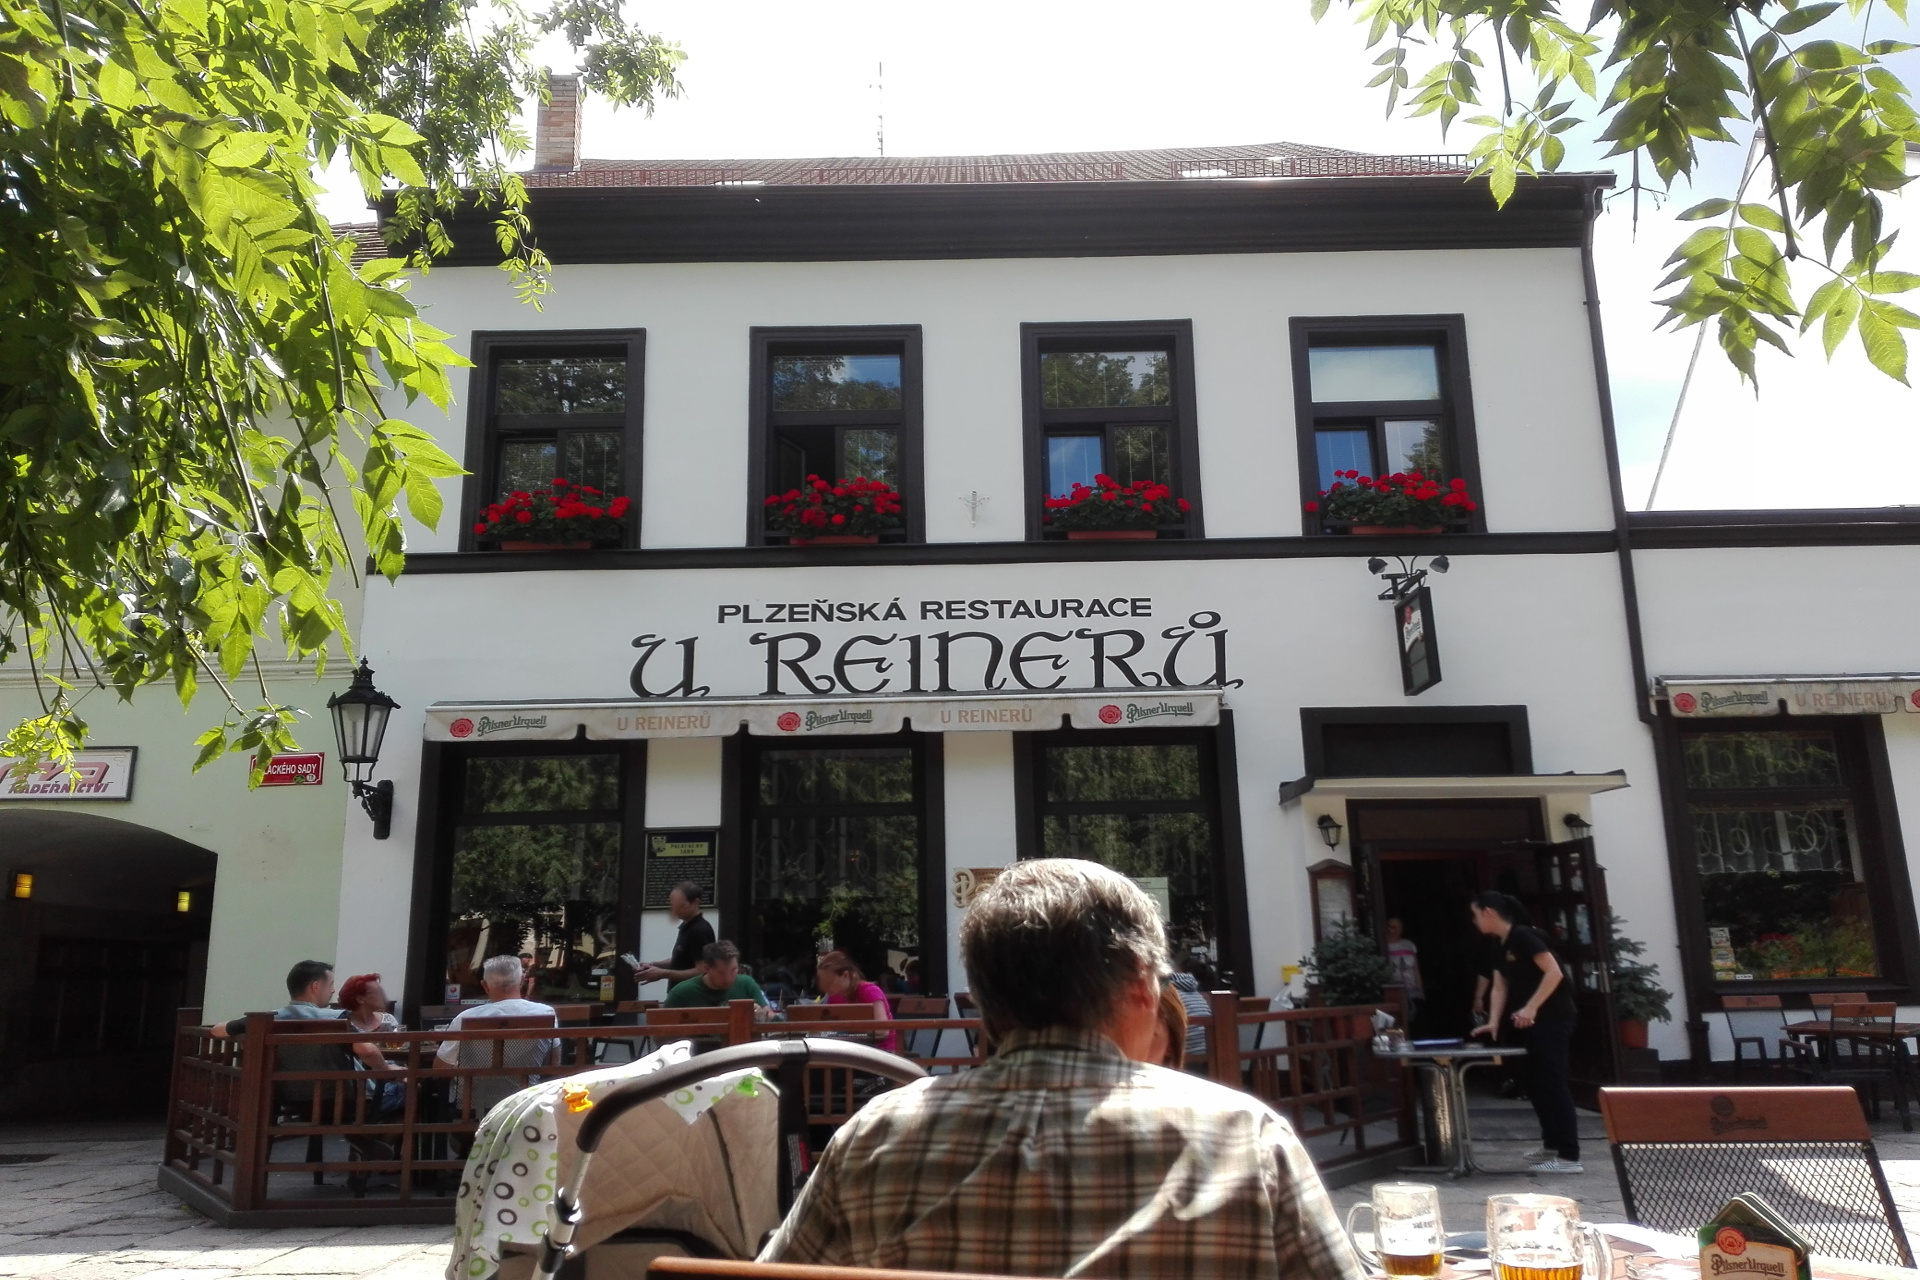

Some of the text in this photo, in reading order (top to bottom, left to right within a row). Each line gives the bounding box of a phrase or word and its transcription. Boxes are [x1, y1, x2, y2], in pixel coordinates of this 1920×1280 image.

[718, 597, 1152, 624] PLZEŇSKÁ RESTAURACE
[629, 611, 1244, 697] U REINERŮ
[1701, 690, 1768, 713] Pilsner Urquell
[1795, 692, 1806, 707] U
[617, 711, 712, 731] U REINERŮ
[805, 709, 873, 731] Pilsner Urquell
[940, 704, 1033, 724] U REINERŮ
[1126, 702, 1194, 723] Pilsner Urquell
[477, 714, 547, 737] Pilsner Urquell
[264, 762, 317, 774] ACKÉHO SADY
[1710, 1253, 1785, 1276] Pilsner Urquell
